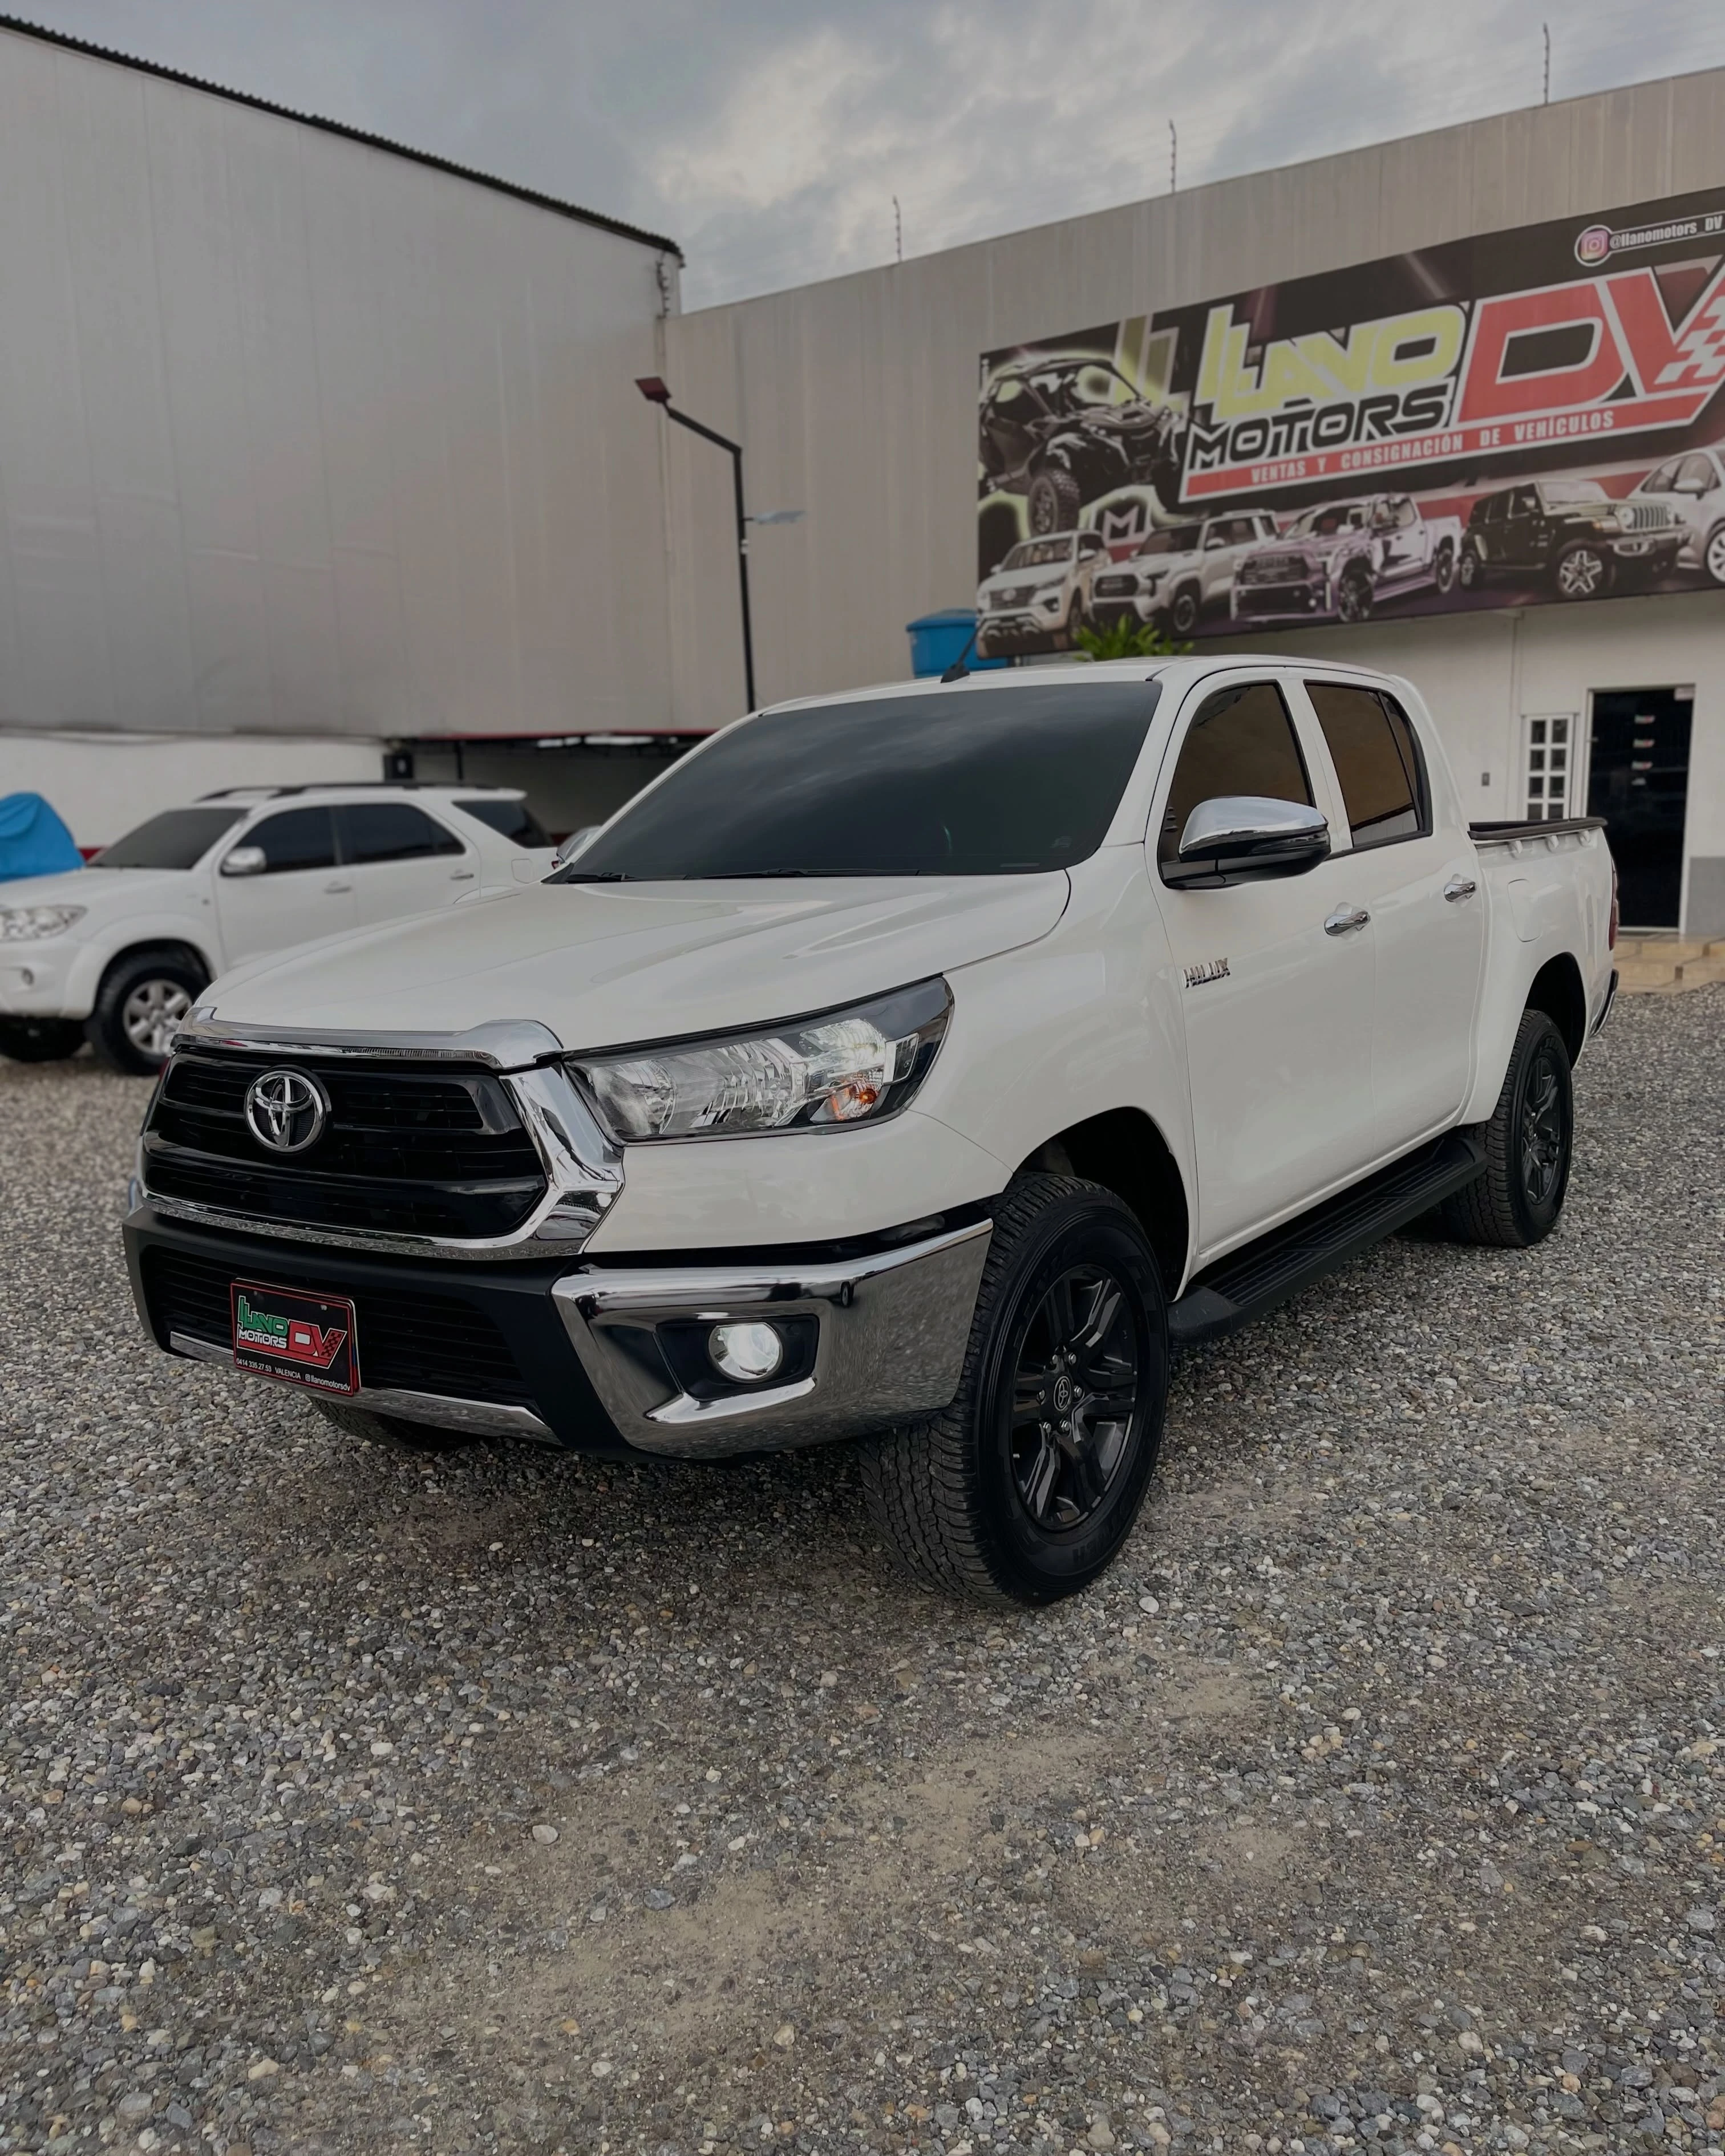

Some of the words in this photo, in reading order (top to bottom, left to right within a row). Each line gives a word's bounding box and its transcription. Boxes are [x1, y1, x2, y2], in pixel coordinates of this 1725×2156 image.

[1195, 304, 1466, 424] LLANO
[1455, 260, 1725, 427] DV
[1188, 384, 1449, 471] MOTORS
[1251, 461, 1306, 484] VENTAS
[1317, 457, 1327, 473] Y
[1341, 432, 1464, 469] CONSIGNACIÓN
[1480, 428, 1501, 447] DE
[1513, 410, 1614, 442] VEHÍCULOS
[238, 1295, 289, 1337] LLANO
[288, 1319, 347, 1360] DV
[238, 1328, 287, 1349] MOTORS
[236, 1357, 248, 1367] 0414
[274, 1367, 301, 1380] VALENCIA
